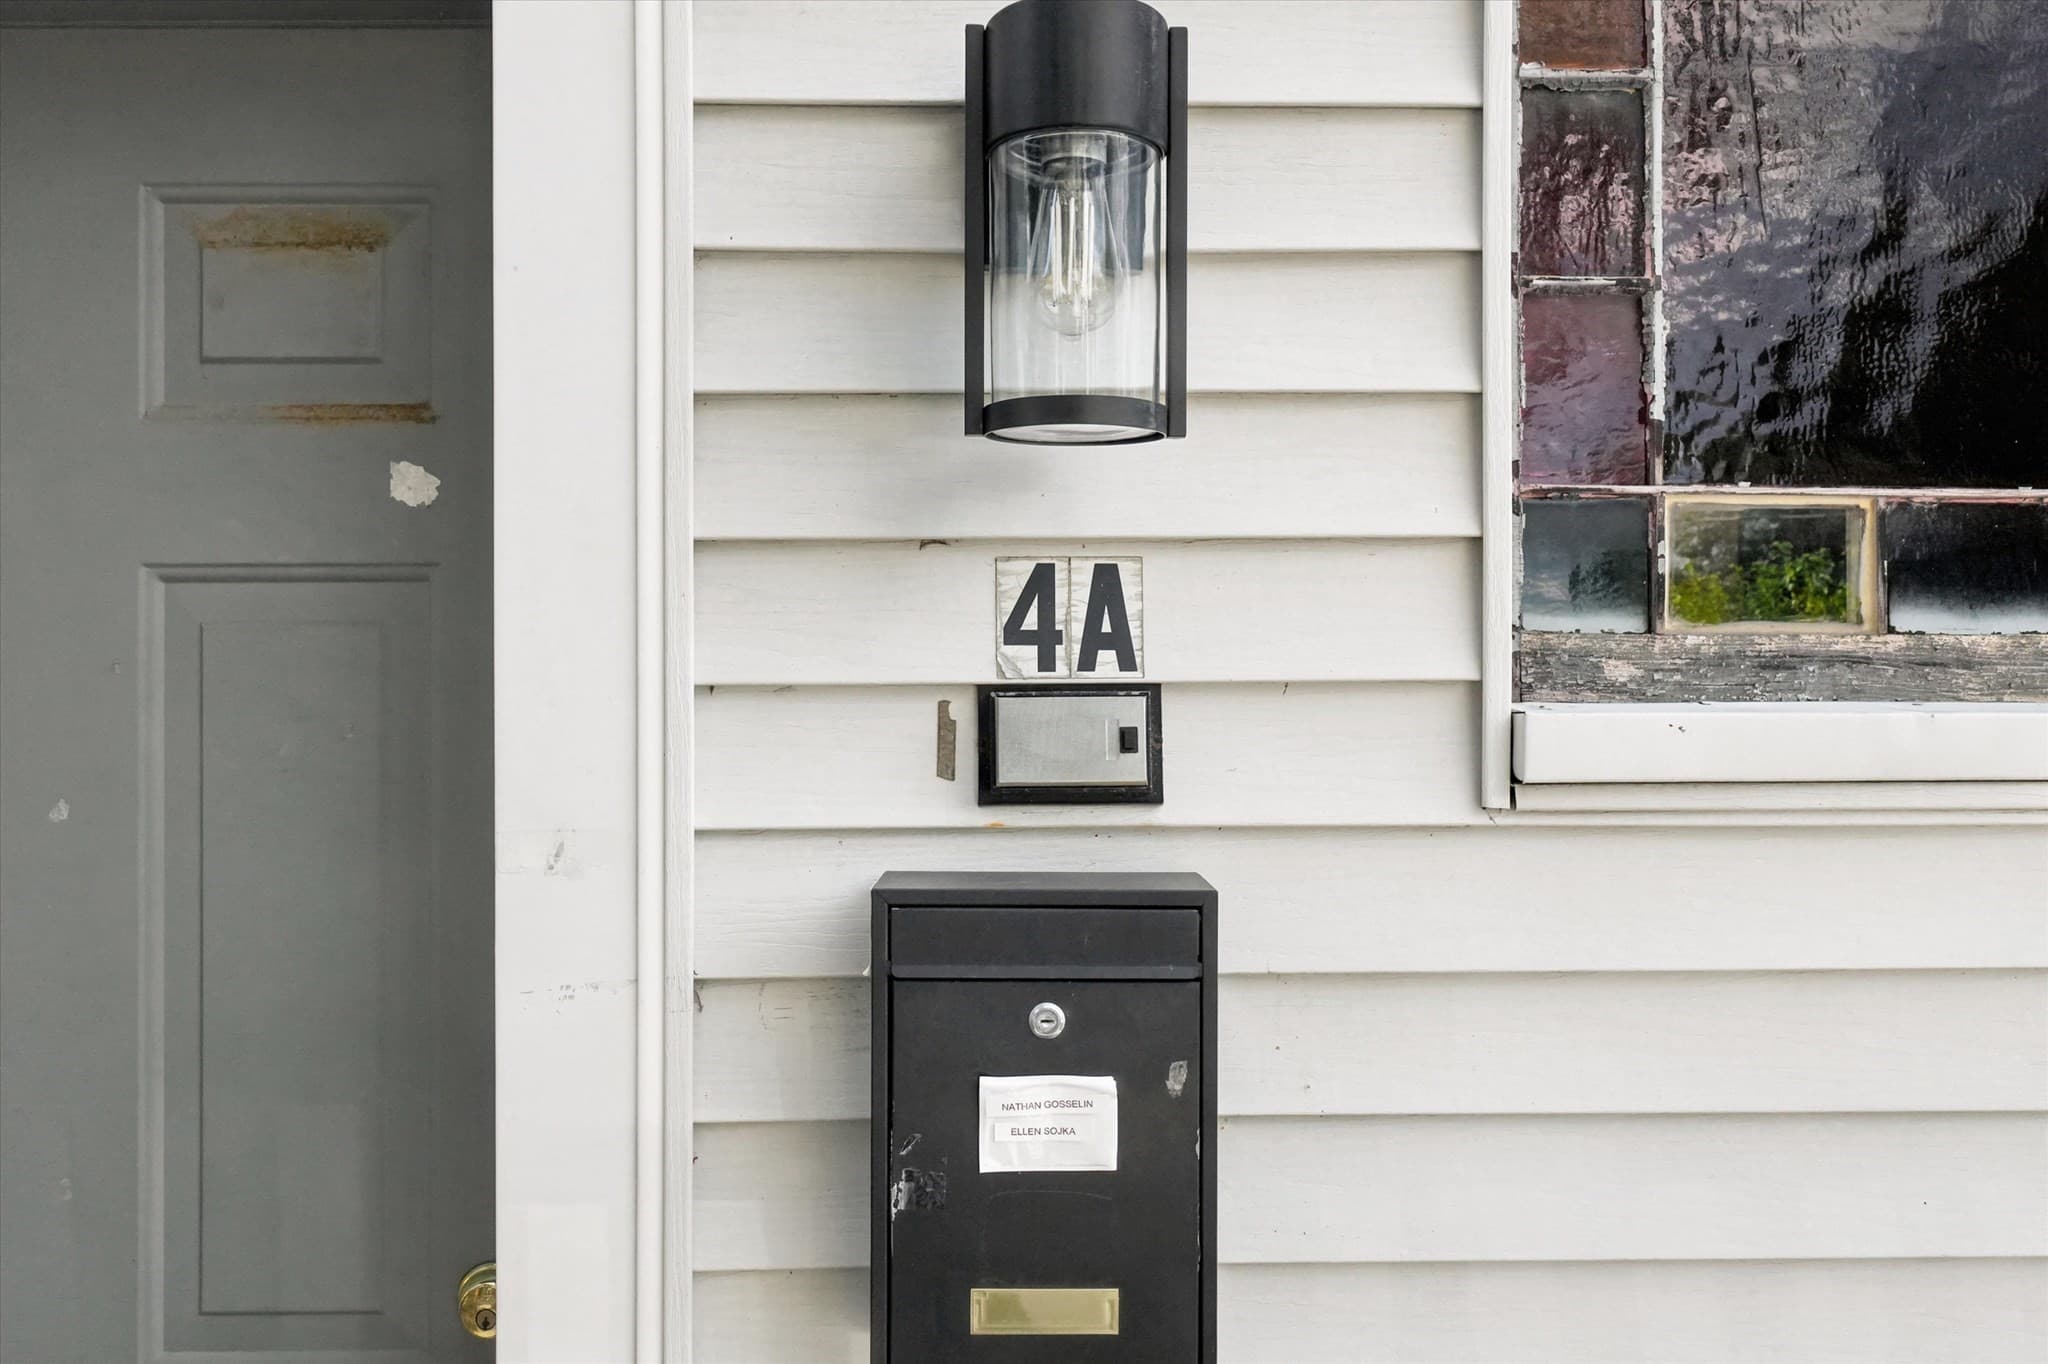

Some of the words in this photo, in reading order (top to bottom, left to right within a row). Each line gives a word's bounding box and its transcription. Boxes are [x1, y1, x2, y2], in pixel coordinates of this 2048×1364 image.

[1003, 562, 1138, 673] 4A
[1001, 1102, 1042, 1111] NATHAN
[1043, 1099, 1094, 1109] GOSSELIN
[1010, 1127, 1041, 1136] ELLEN
[1043, 1127, 1076, 1136] SOJKA
